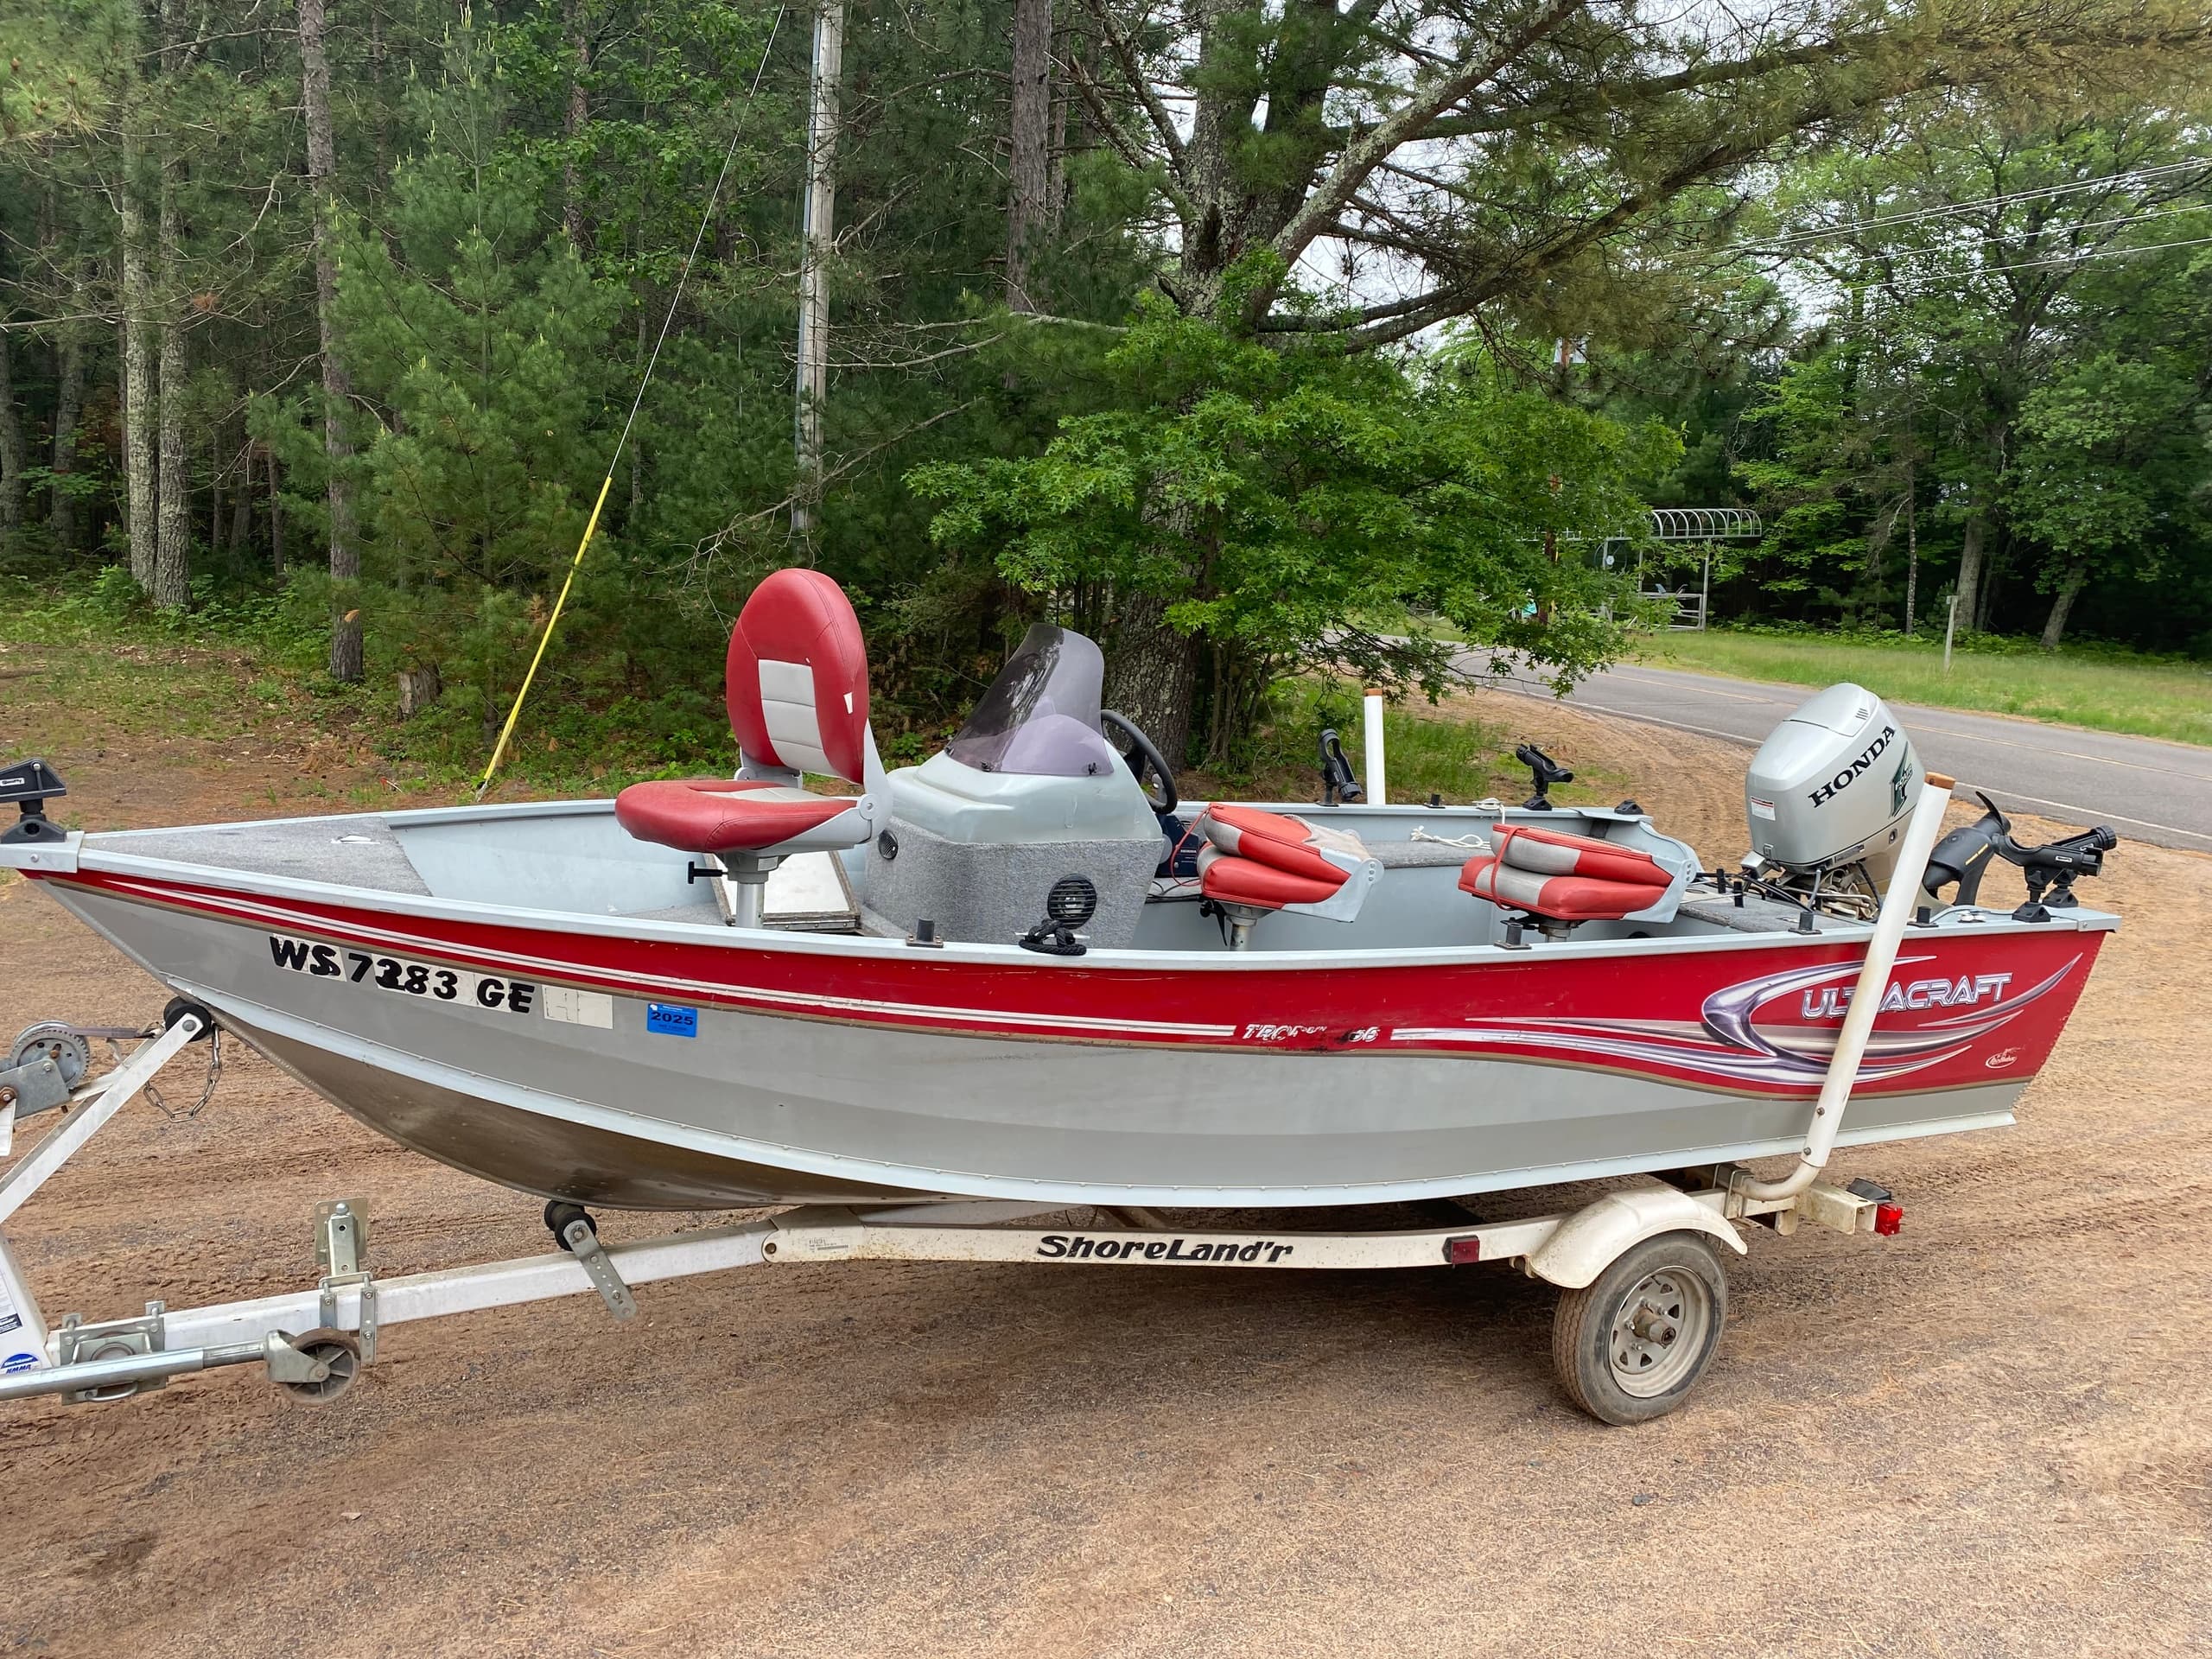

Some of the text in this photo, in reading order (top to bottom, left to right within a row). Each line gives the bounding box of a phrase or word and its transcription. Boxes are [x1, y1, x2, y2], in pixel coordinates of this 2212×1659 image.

[1808, 725, 1896, 808] HONDA
[269, 936, 341, 976] WS
[477, 978, 535, 1014] GE
[1802, 972, 2013, 1020] ULACRAFT
[651, 1011, 694, 1026] 2025
[1037, 1235, 1294, 1262] ShoreLand'r
